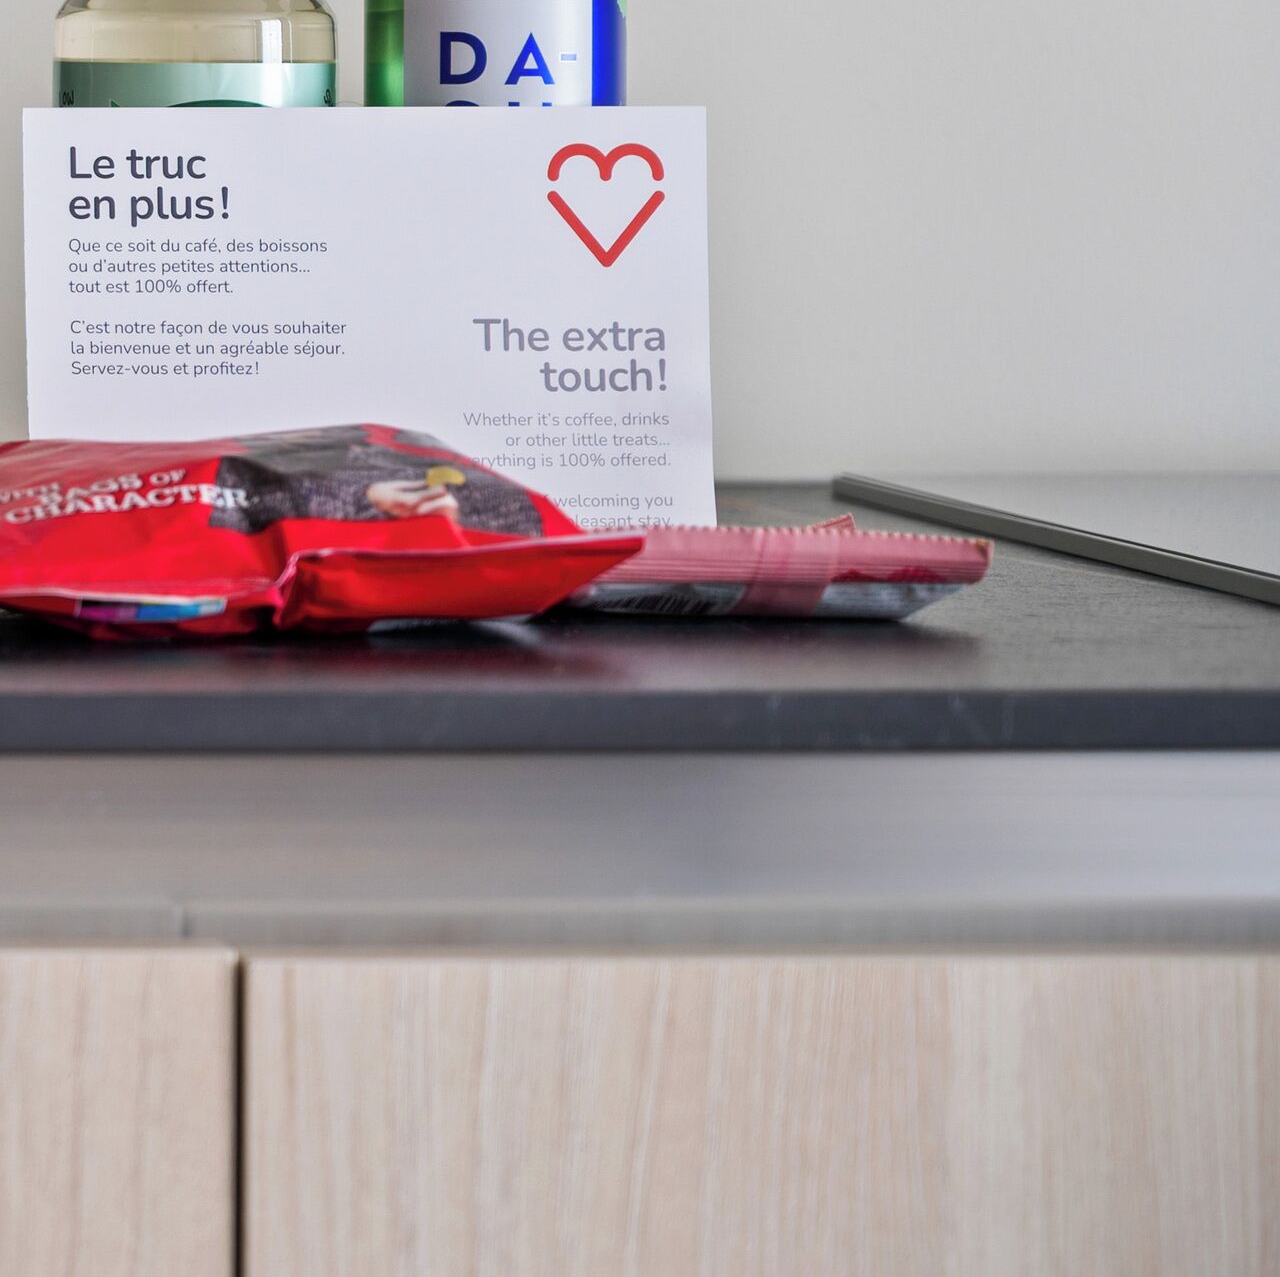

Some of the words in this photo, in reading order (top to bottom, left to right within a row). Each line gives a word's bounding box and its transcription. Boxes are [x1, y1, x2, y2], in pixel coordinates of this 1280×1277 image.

[69, 146, 115, 179] Le
[126, 149, 207, 179] truc
[69, 195, 116, 220] en
[68, 238, 101, 254] Que
[105, 241, 123, 253] ce
[127, 238, 156, 253] soit
[160, 238, 181, 253] du
[184, 237, 222, 255] café,
[226, 238, 254, 253] des
[259, 238, 328, 253] boissons
[68, 261, 88, 273] ou
[93, 259, 157, 273] d’autres
[161, 259, 215, 276] petites
[68, 280, 101, 294] tout
[105, 280, 130, 294] est
[135, 279, 182, 294] 100%
[186, 279, 234, 294] offert.
[70, 320, 111, 335] C’est
[114, 321, 156, 335] notre
[160, 320, 203, 337] façon
[208, 320, 228, 335] de
[232, 323, 269, 335] vous
[273, 320, 347, 335] souhaiter
[472, 318, 549, 352] The
[562, 321, 666, 352] extra
[70, 341, 85, 355] la
[89, 341, 171, 355] bienvenue
[175, 342, 191, 355] et
[196, 344, 215, 355] un
[220, 340, 289, 358] agréable
[293, 340, 346, 358] séjour.
[71, 361, 169, 376] Servez-vous
[173, 363, 189, 376] et
[539, 358, 668, 392] touch!
[463, 412, 533, 427] Whether
[537, 412, 560, 427] it’s
[565, 412, 617, 428] coffee,
[622, 411, 670, 426] drinks
[505, 436, 521, 447] or
[526, 433, 568, 447] other
[572, 432, 608, 447] little
[541, 453, 553, 467] is
[559, 452, 605, 467] 100%
[610, 451, 671, 467] offered.
[40, 472, 142, 506] BAGS
[149, 468, 187, 487] OF
[554, 493, 640, 510] welcoming
[644, 496, 673, 510] you
